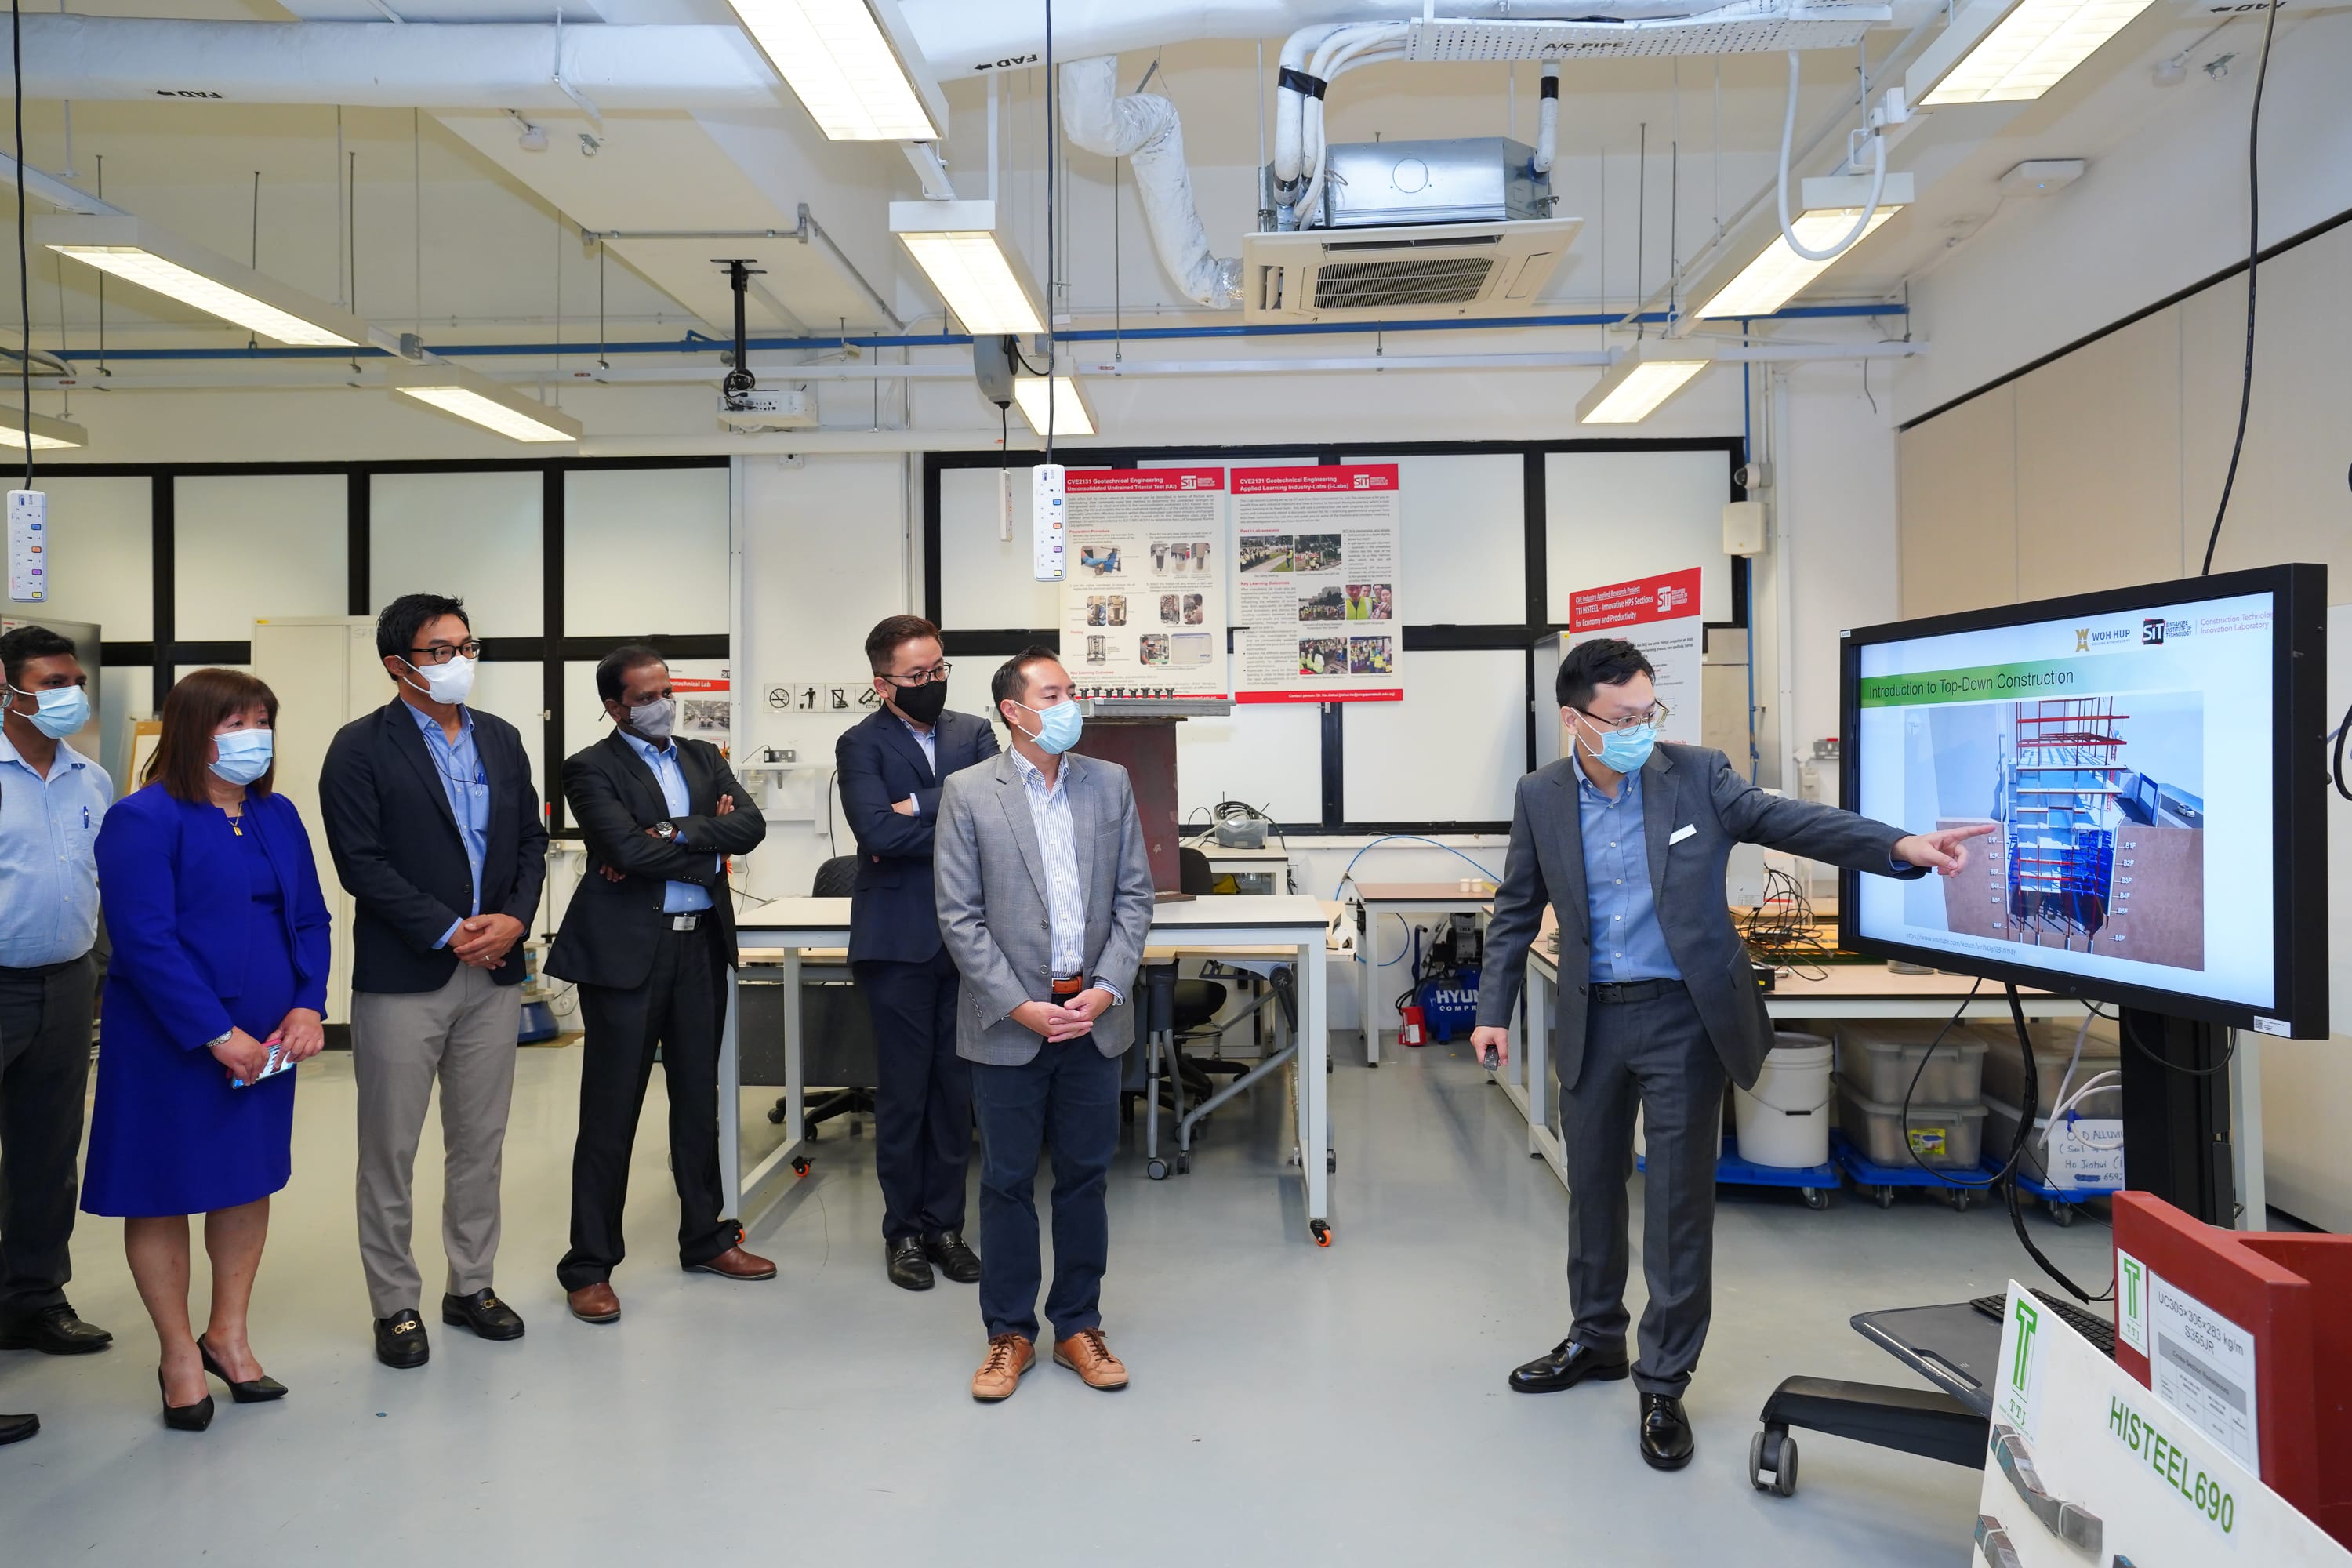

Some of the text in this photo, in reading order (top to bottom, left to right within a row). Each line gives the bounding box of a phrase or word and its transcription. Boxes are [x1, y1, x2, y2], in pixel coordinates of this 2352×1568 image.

[996, 54, 1038, 67] FAD
[1583, 594, 1596, 603] Industry
[1597, 591, 1610, 601] Applied
[1610, 589, 1627, 597] Research
[1627, 586, 1640, 596] Project
[1602, 600, 1624, 610] Innovative
[1634, 595, 1653, 605] Sections
[1582, 617, 1601, 628] Economy
[1610, 612, 1636, 622] Productivity
[2201, 615, 2240, 626] Construction
[2201, 621, 2270, 634] Innovation Laboratory
[2092, 629, 2130, 641] WOH HUP
[1869, 669, 2074, 699] Introduction to Top-Down Construction
[2067, 1130, 2123, 1141] OD ALLUVI
[2065, 1160, 2077, 1168] Ho
[2184, 1325, 2215, 1355] S355JR
[2223, 1332, 2244, 1356] kg/m
[2010, 1398, 2027, 1426] TTJ
[2109, 1395, 2234, 1534] HISTEEL690
